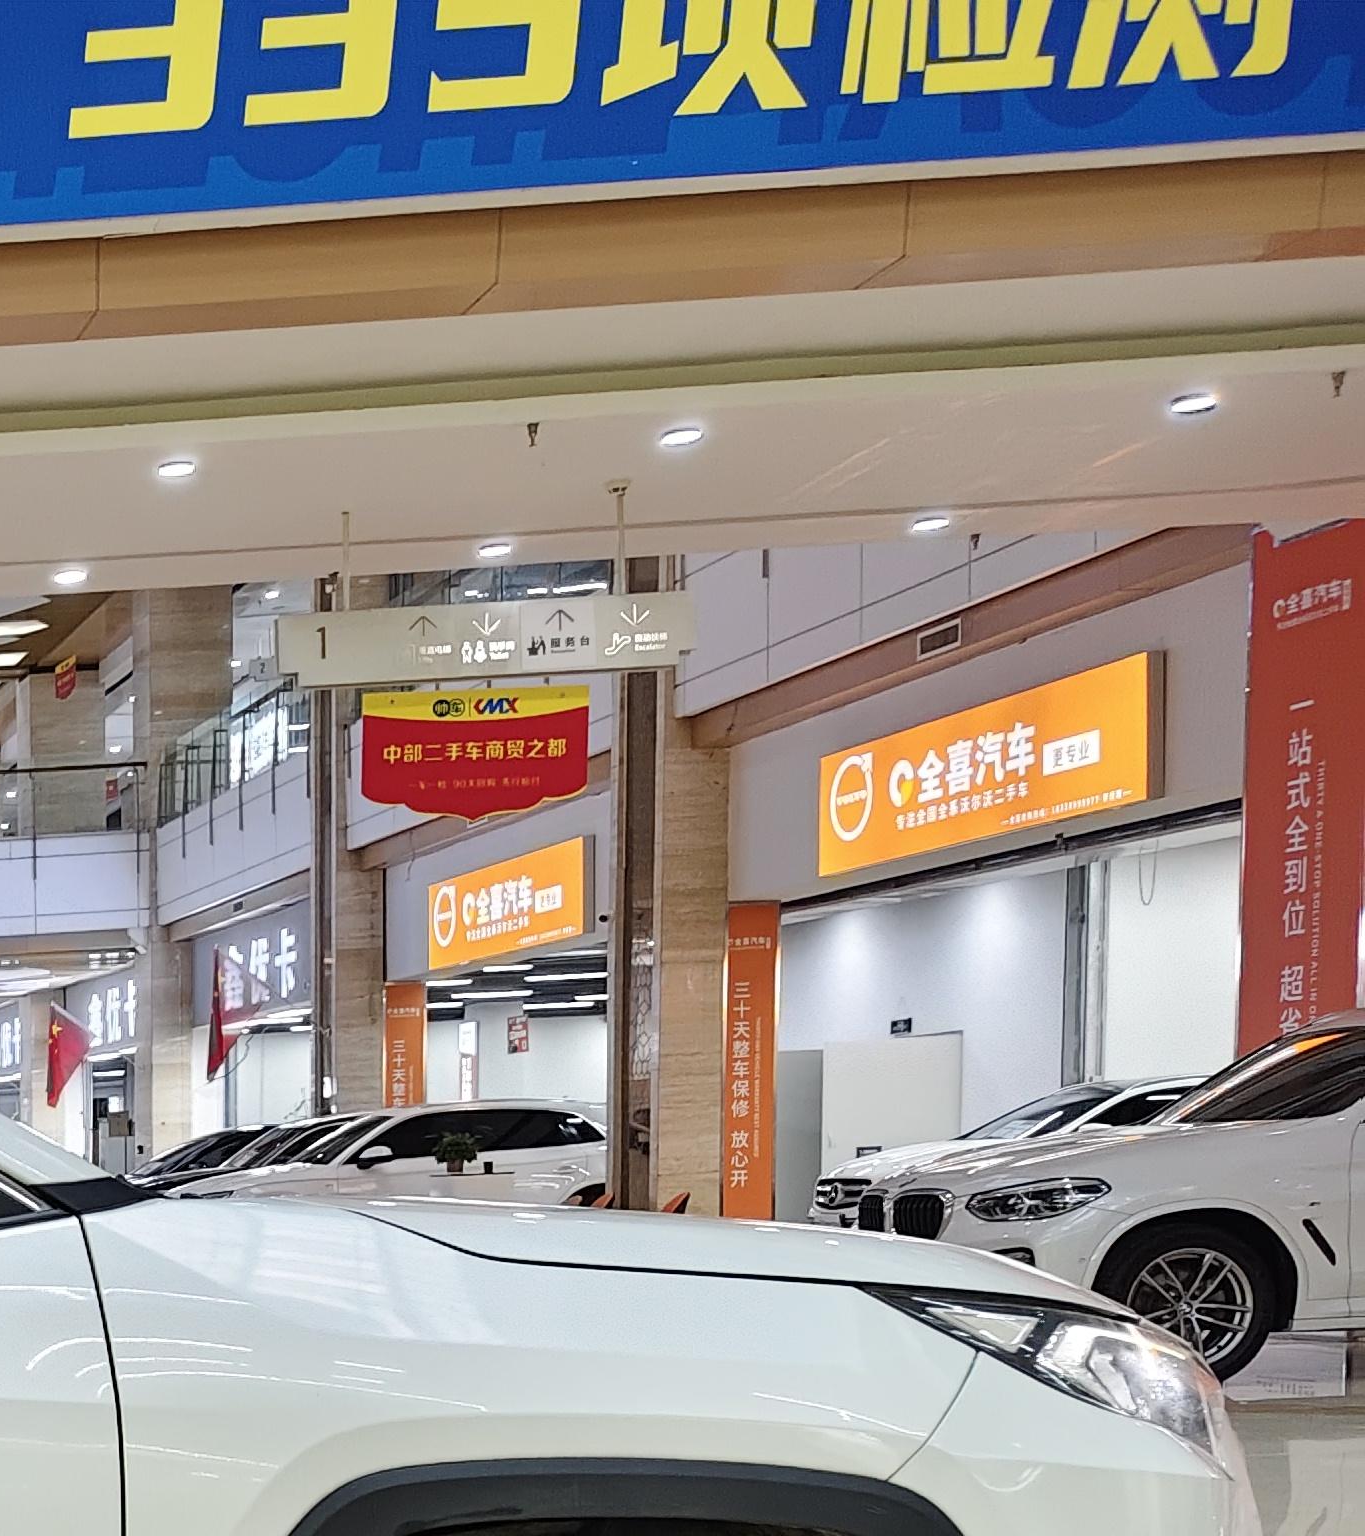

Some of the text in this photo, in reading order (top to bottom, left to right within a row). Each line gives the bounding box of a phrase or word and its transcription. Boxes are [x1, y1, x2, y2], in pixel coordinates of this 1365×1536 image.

[315, 626, 327, 660] 1
[550, 636, 590, 649] 服务台
[383, 737, 567, 766] 中部二手车商贸之都
[1282, 699, 1315, 938] 一站式全到位
[730, 981, 751, 1188] 三十天整车保修 放心开
